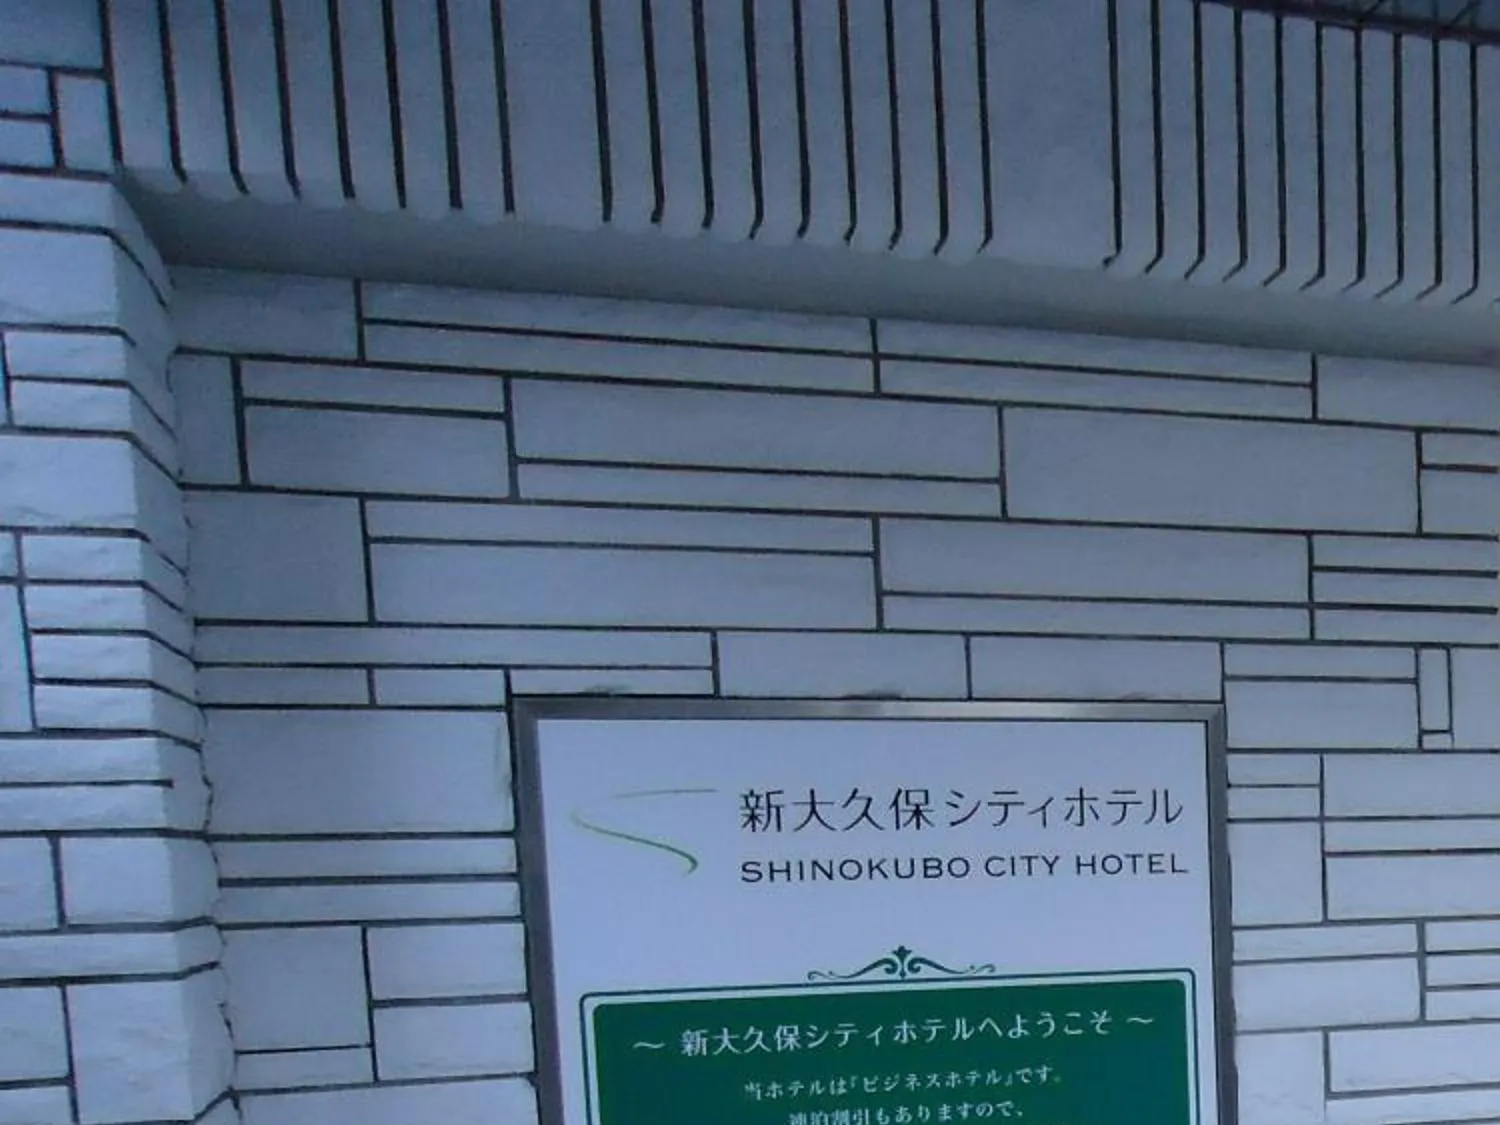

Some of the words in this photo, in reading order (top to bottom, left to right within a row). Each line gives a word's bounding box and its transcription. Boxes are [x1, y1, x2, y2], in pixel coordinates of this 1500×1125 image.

[740, 787, 1183, 832] 新大久保シティホテル
[742, 857, 970, 882] SHINOKUBO
[984, 856, 1060, 877] CITY
[1076, 853, 1188, 875] HOTEL
